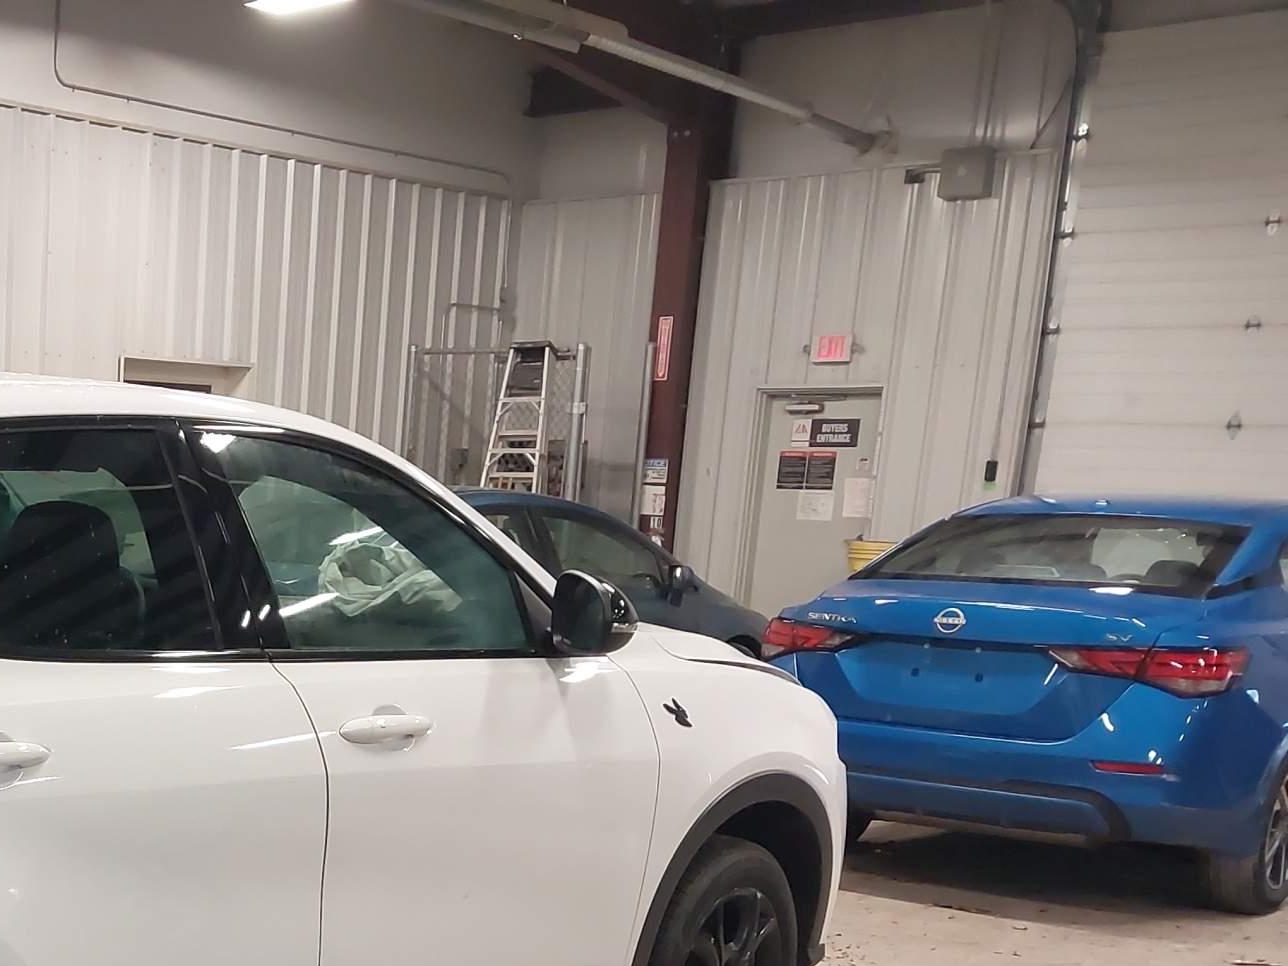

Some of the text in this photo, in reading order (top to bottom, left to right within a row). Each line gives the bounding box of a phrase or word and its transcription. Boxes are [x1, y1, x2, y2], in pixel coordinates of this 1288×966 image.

[821, 423, 849, 433] BUYERS
[816, 433, 852, 443] ENTRANCE
[807, 611, 857, 624] SENTRA
